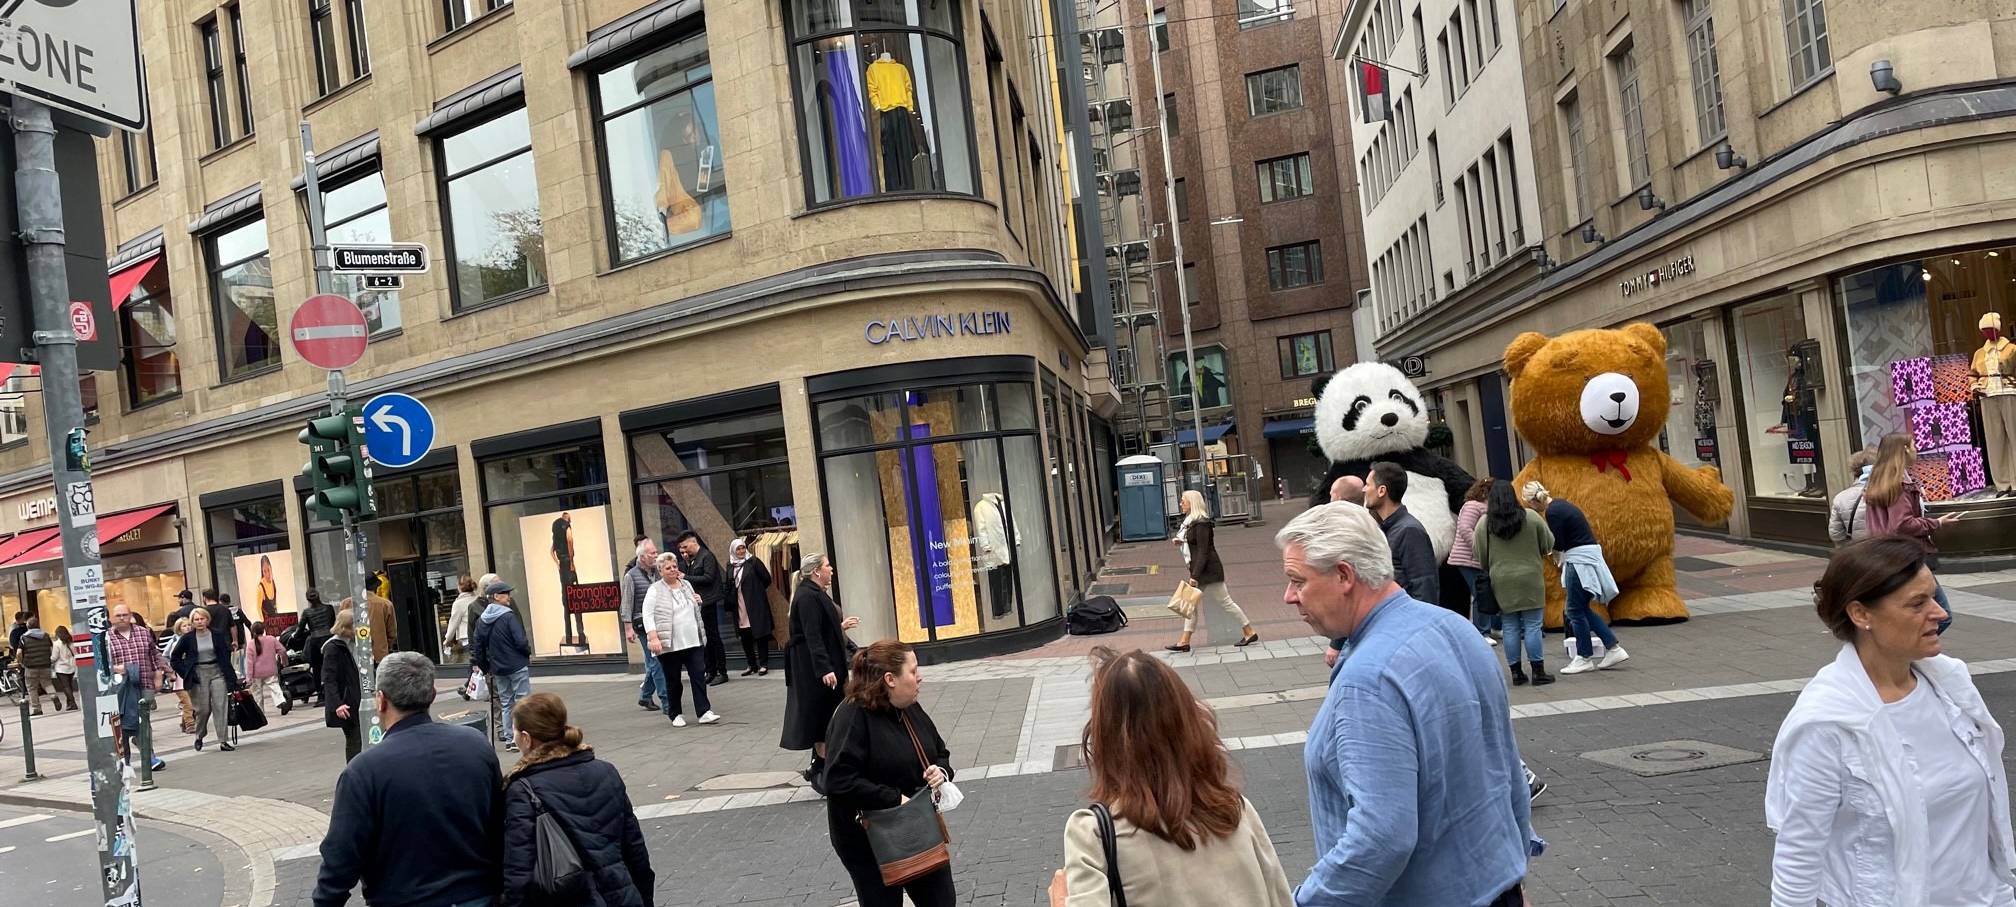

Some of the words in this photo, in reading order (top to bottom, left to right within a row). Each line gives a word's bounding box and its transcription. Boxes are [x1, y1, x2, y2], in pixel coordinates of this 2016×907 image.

[343, 251, 416, 265] Blumenstraße
[1619, 273, 1650, 297] TOMMY
[1658, 255, 1696, 282] HILFIGER
[864, 313, 953, 345] CALVIN
[959, 311, 1011, 336] KLEIN
[18, 497, 58, 521] WEMP
[929, 540, 951, 551] New
[566, 585, 619, 600] Promotion
[568, 599, 579, 613] Up
[580, 599, 589, 610] to
[591, 597, 607, 609] 30%
